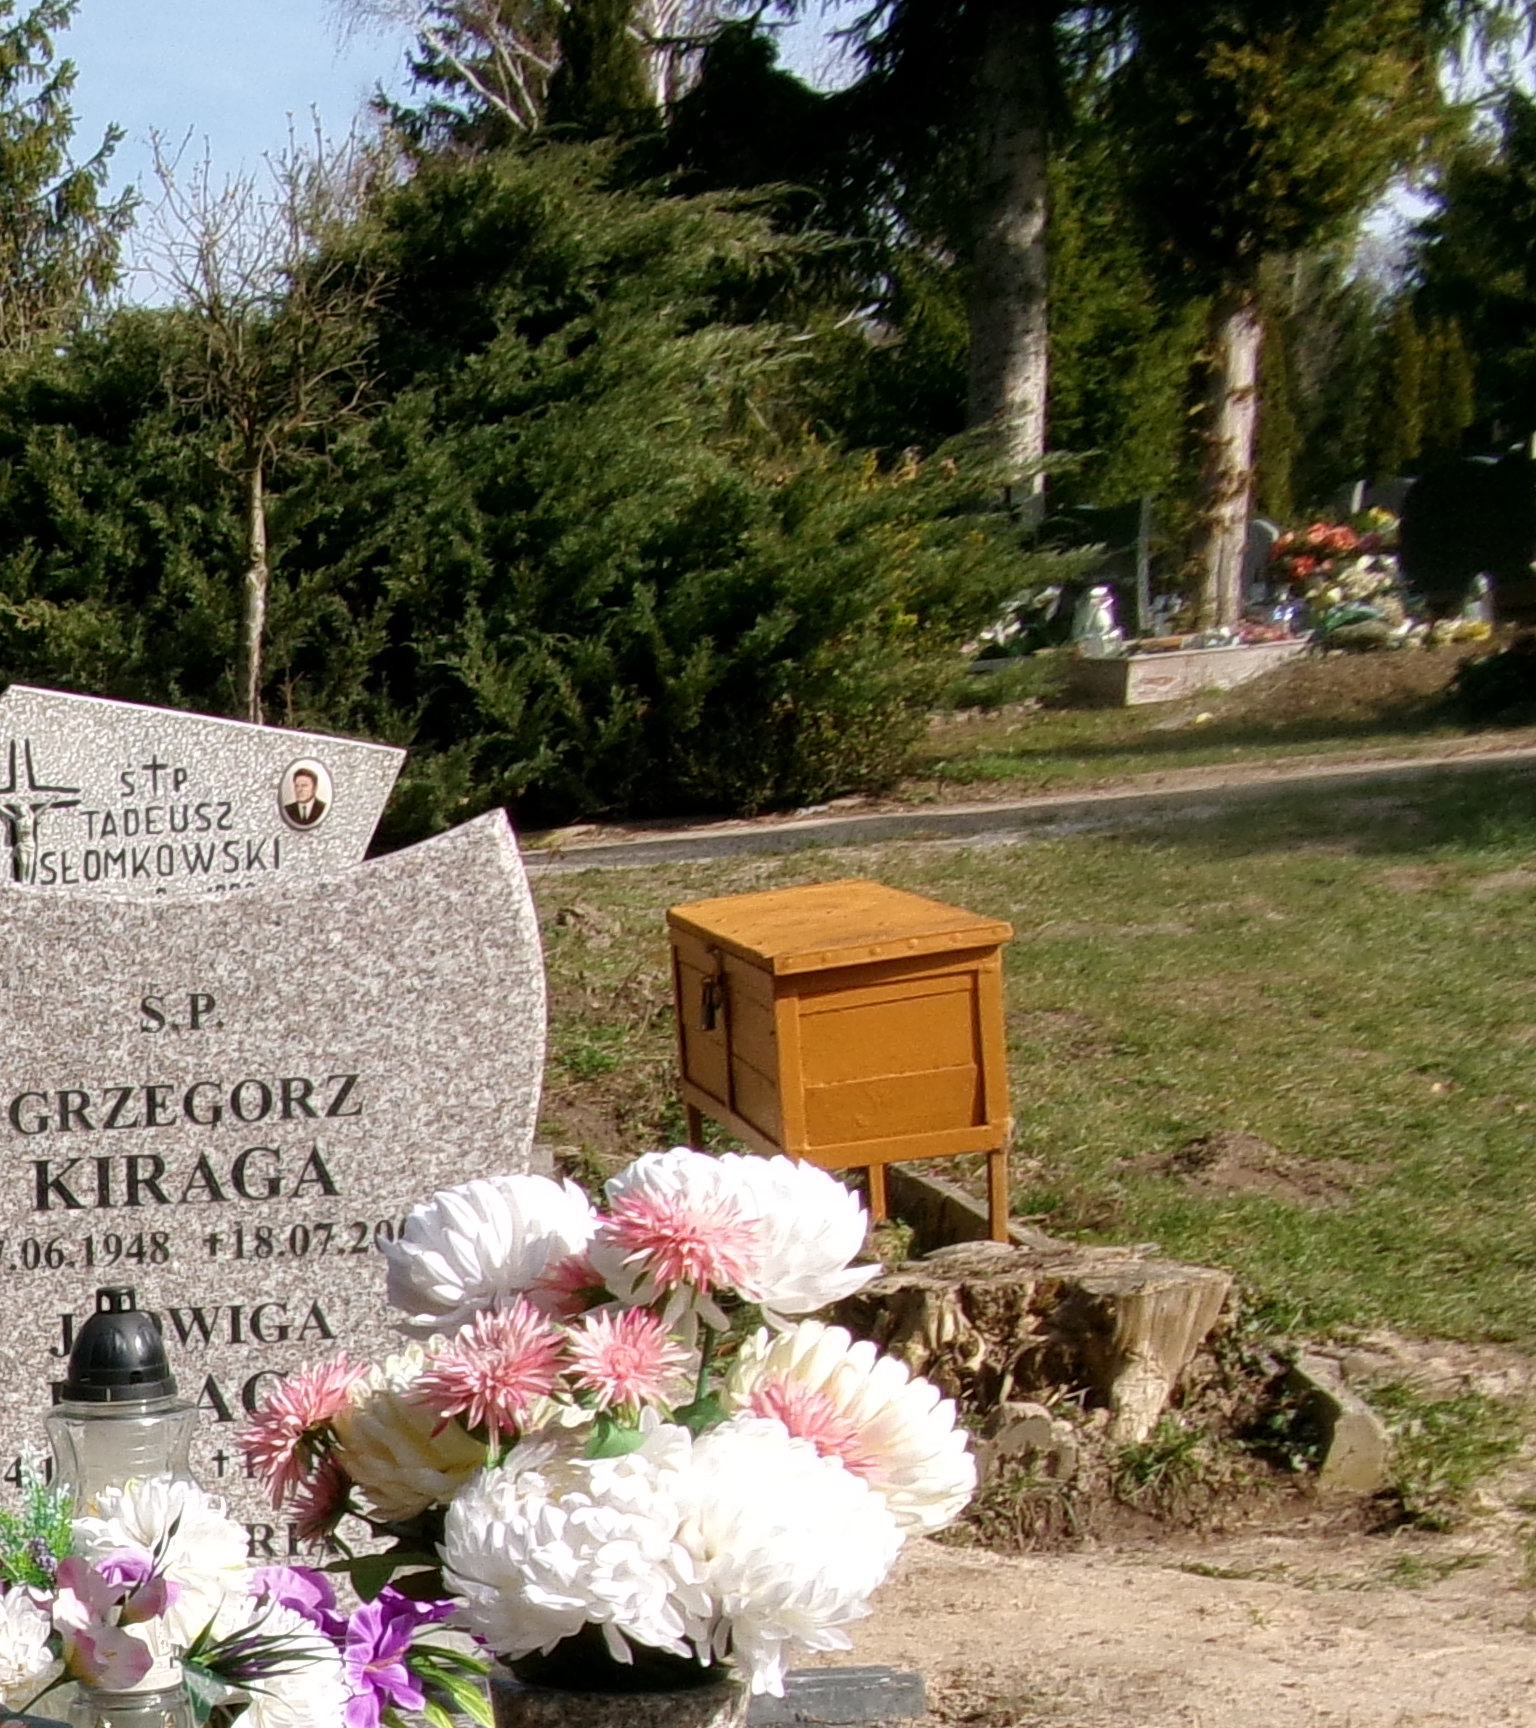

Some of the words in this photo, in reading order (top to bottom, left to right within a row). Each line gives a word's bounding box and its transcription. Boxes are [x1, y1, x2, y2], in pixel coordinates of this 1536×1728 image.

[81, 801, 233, 839] TADEUSZ
[40, 837, 281, 885] SŁOMKOWSKI
[9, 1073, 364, 1137] GRZEGORZ
[33, 1145, 340, 1211] KIRAGA
[235, 1218, 407, 1260] 18.07.20
[49, 1300, 339, 1358] JWIGA
